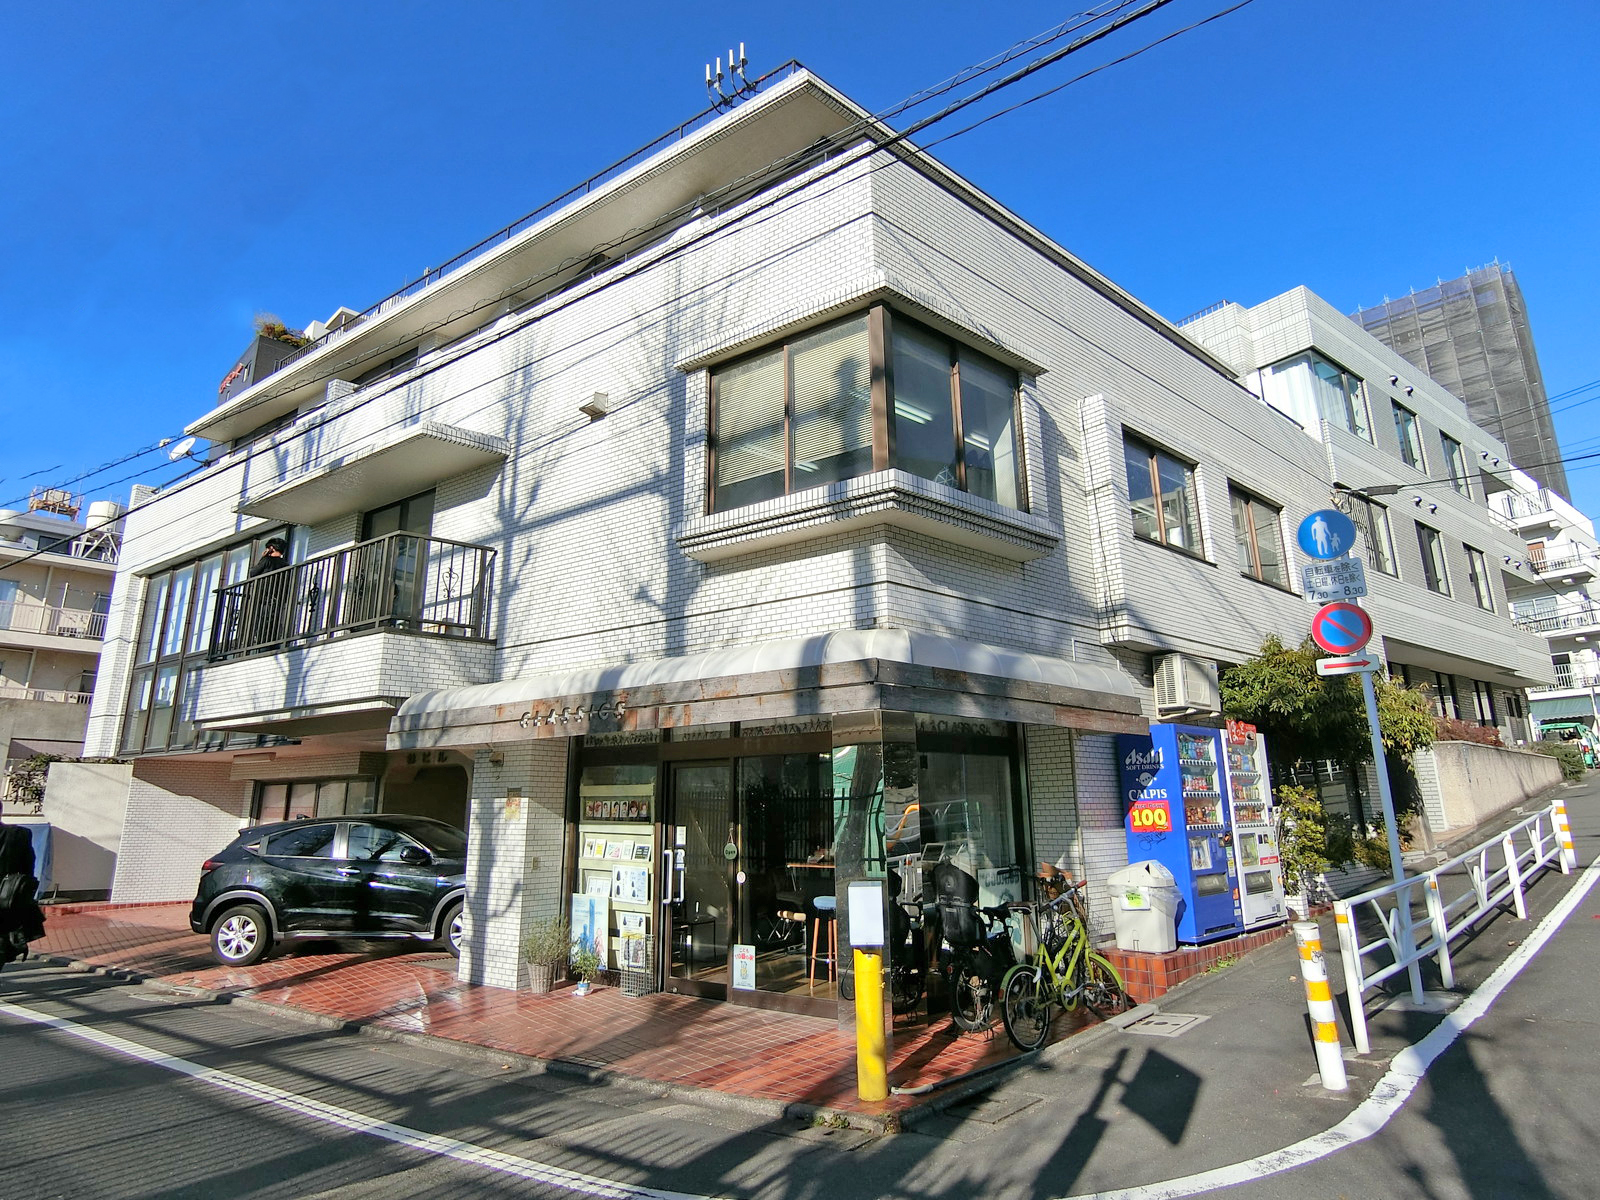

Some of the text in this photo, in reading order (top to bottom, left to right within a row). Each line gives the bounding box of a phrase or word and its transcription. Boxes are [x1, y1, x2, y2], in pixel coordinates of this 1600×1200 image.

[1305, 562, 1358, 577] 自転車を除く
[520, 701, 626, 728] CLASSICS
[1125, 747, 1163, 765] Asahi
[1128, 788, 1168, 802] CALPIS
[1132, 808, 1167, 827] 100
